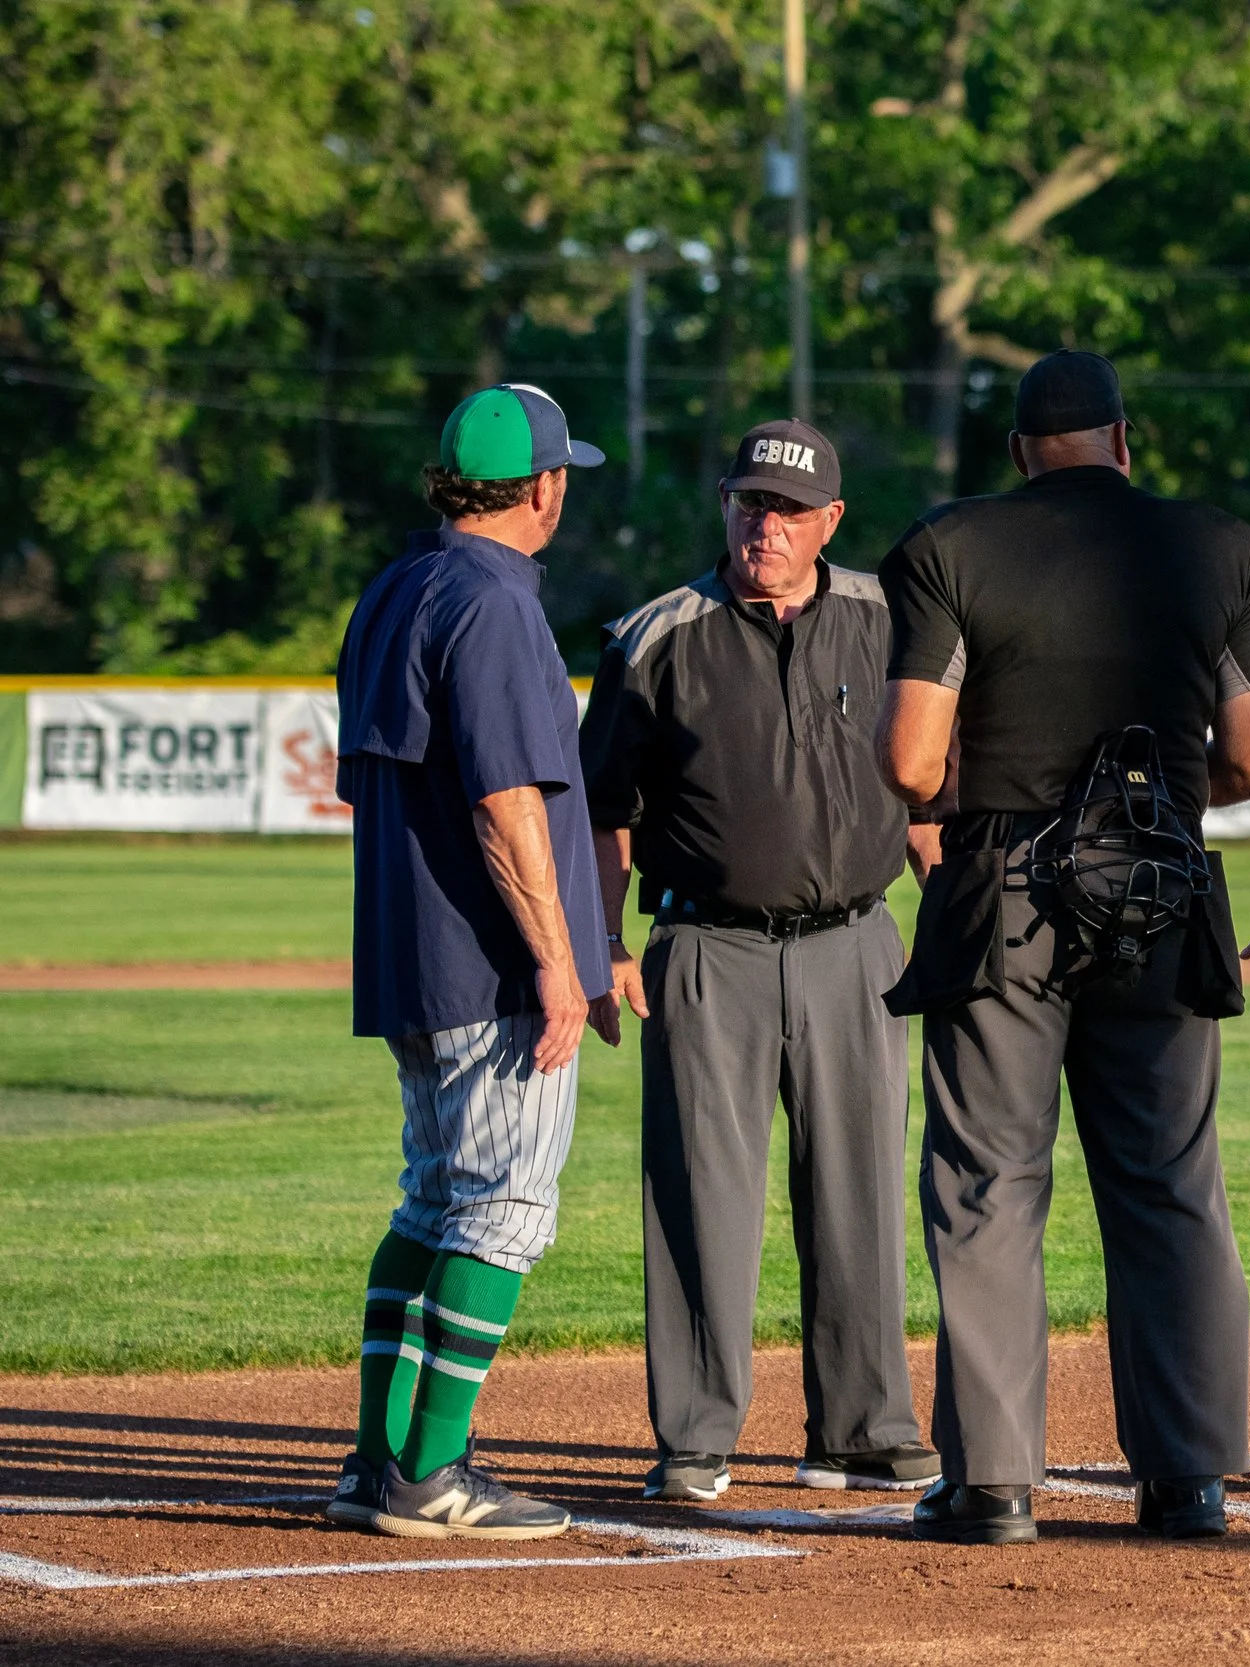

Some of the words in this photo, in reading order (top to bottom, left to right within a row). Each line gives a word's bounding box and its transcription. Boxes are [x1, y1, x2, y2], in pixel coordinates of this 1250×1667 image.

[752, 439, 815, 473] CBUA
[118, 723, 252, 764] FORT
[117, 772, 249, 791] FREIGHT
